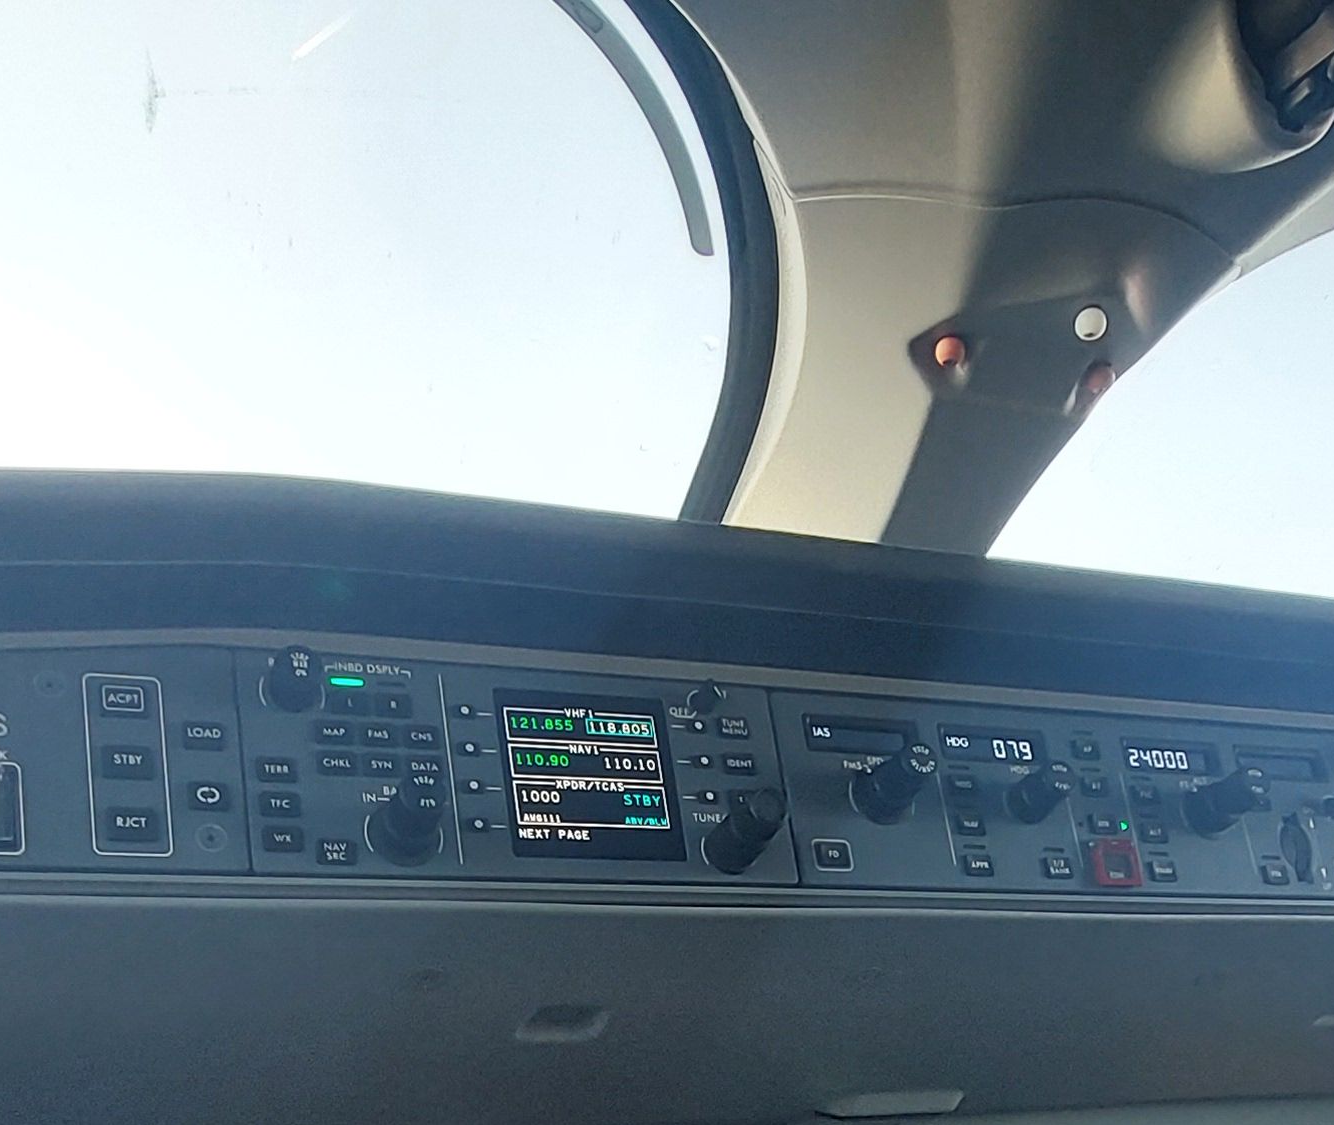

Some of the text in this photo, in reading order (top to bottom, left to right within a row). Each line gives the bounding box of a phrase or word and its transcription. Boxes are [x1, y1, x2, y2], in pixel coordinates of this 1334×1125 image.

[107, 692, 138, 704] ACPT
[564, 708, 594, 719] VHF1
[323, 727, 345, 736] MAP
[511, 716, 650, 735] 121.855 118.805
[187, 727, 220, 739] LOAD
[812, 727, 830, 738] IAS
[569, 744, 599, 755] NAV1
[946, 736, 1032, 760] HDG 079
[114, 754, 142, 766] STBY
[323, 758, 350, 768] CHKL
[371, 760, 393, 770] SYN
[516, 754, 656, 772] 110.90 110.10
[727, 759, 753, 768] IDENT
[1129, 749, 1188, 770] 24000
[555, 780, 625, 792] XPDR/TCAS
[522, 790, 661, 807] 1000 STBY
[116, 816, 146, 828] RJCT
[693, 813, 722, 823] TUNE
[519, 829, 590, 841] NEXT PAGE
[324, 842, 346, 851] NAV
